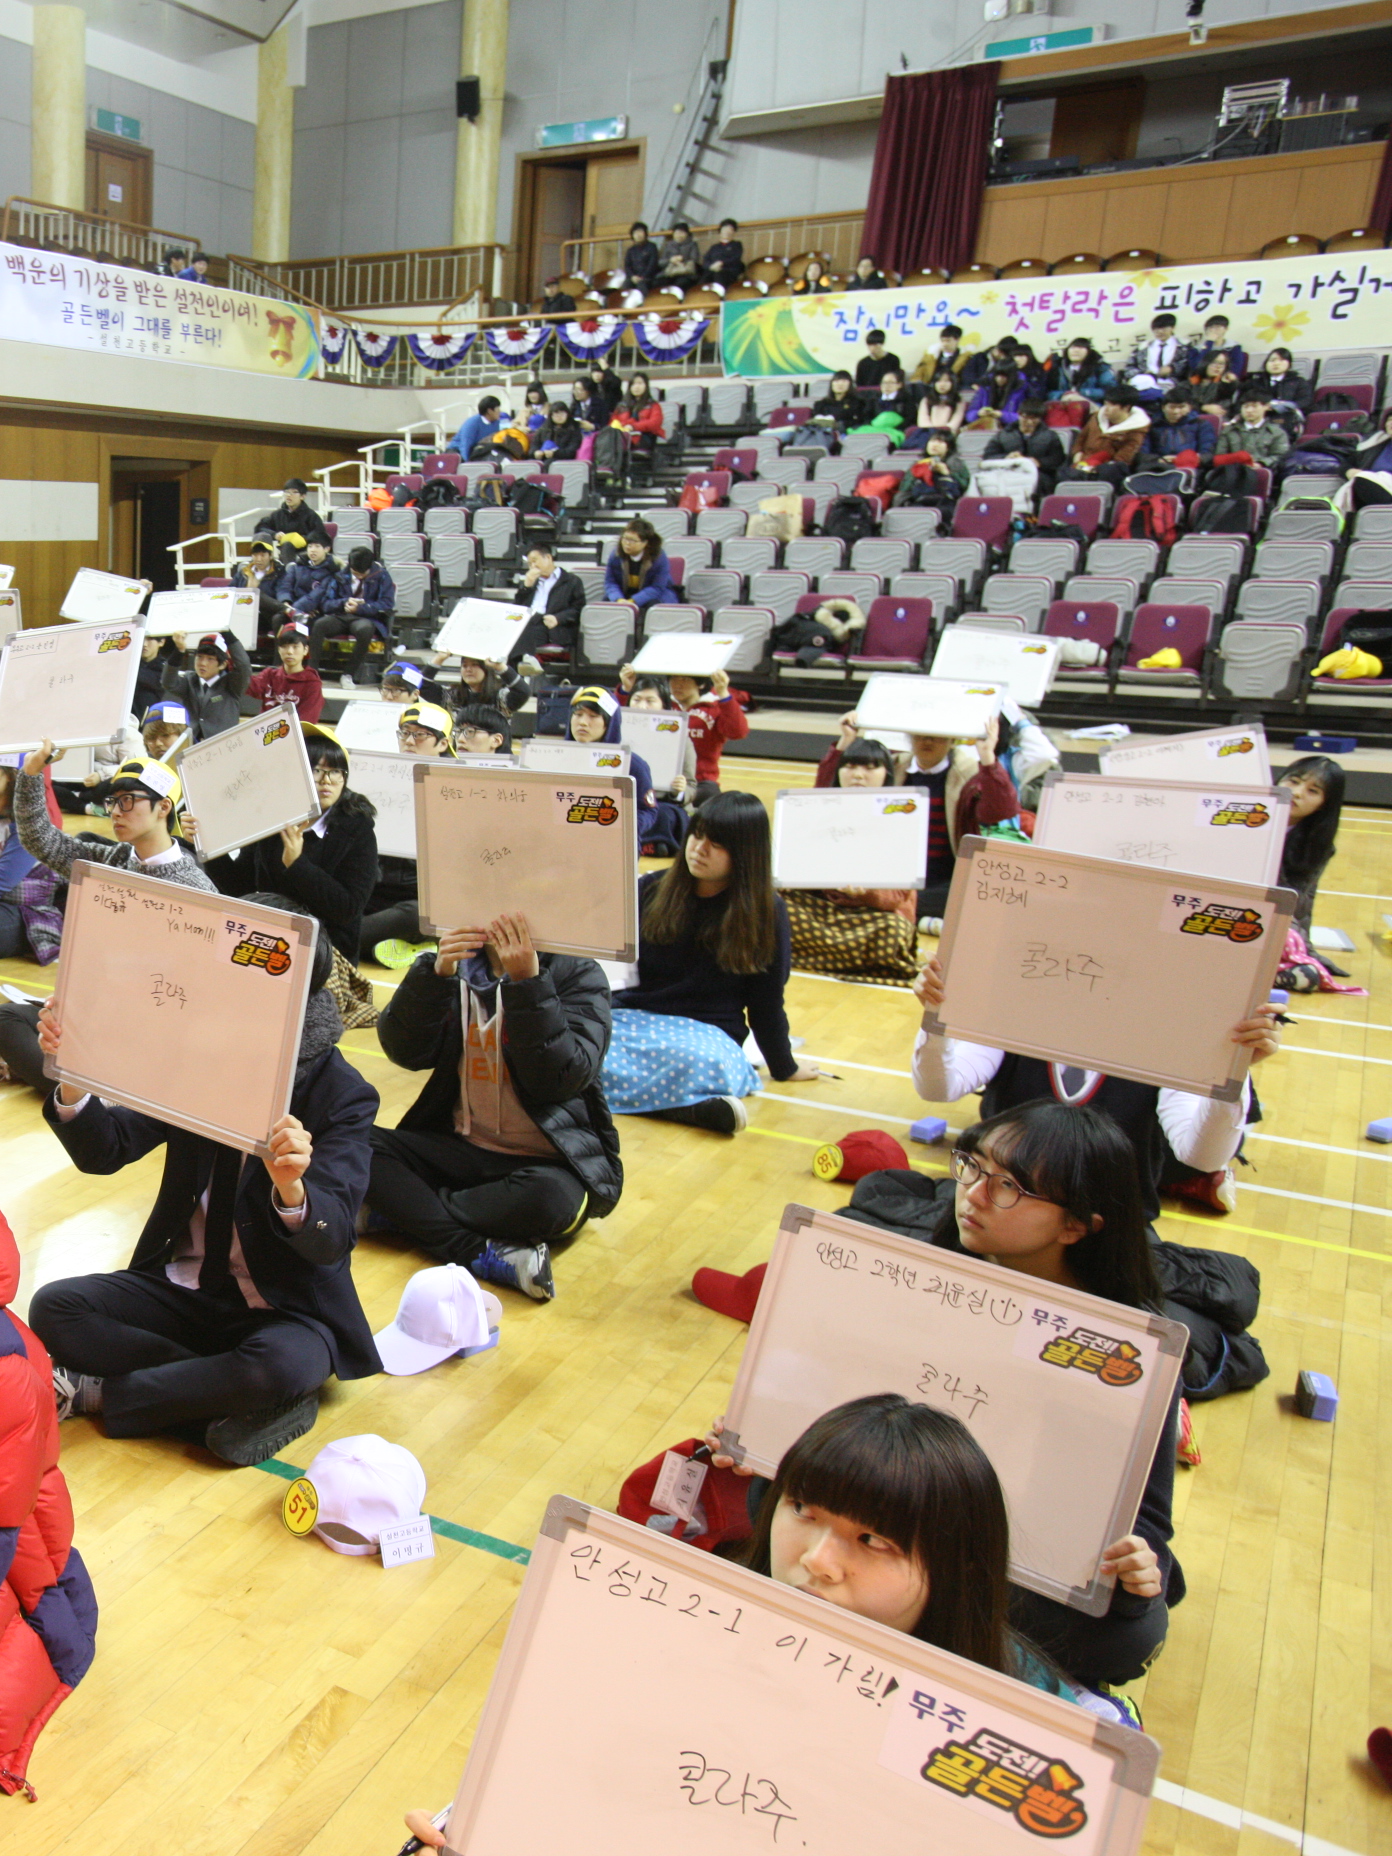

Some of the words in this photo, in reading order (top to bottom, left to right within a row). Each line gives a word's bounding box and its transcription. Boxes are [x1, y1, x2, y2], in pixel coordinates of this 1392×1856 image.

[5, 254, 66, 291] 백운의
[74, 268, 129, 303] 기상을
[133, 280, 168, 309] 받은
[174, 288, 259, 327] 설천인이여!
[1005, 286, 1136, 333] 첫탈락은
[1154, 278, 1261, 313] 피하고
[60, 300, 125, 332] 골든벨이
[132, 315, 173, 340] 그대를
[180, 322, 223, 349] 부른다!
[469, 787, 488, 800] 1-2
[556, 791, 576, 802] 무주
[1202, 798, 1223, 808] 무주
[568, 806, 618, 825] 골든벨
[1211, 811, 1269, 827] 골든벨
[977, 858, 1027, 882] 안성고
[1035, 871, 1070, 890] 2-2
[976, 880, 1029, 908] 김지혜
[1171, 894, 1202, 910] 무주
[1181, 914, 1264, 942] 골든벨
[1206, 904, 1245, 921] 도전!
[225, 920, 247, 937] 무주
[250, 932, 277, 950] 도전!
[233, 942, 292, 975] 골든벨
[1020, 942, 1105, 993] 콜라주
[150, 973, 188, 1010] 콜라주
[817, 1153, 833, 1174] 85
[869, 1258, 918, 1291] 2학년
[922, 1274, 989, 1316] 최윤실
[1030, 1307, 1069, 1332] 무주
[1064, 1327, 1118, 1354] 도전!
[1041, 1338, 1144, 1386] 골든벨
[915, 1361, 989, 1420] 콜라주
[288, 1493, 308, 1524] 51
[570, 1542, 671, 1607] 안성고
[681, 1593, 744, 1637] 2-1
[908, 1689, 967, 1733] 무주
[968, 1732, 1049, 1780] 도전!
[924, 1743, 1091, 1839] 골든벨
